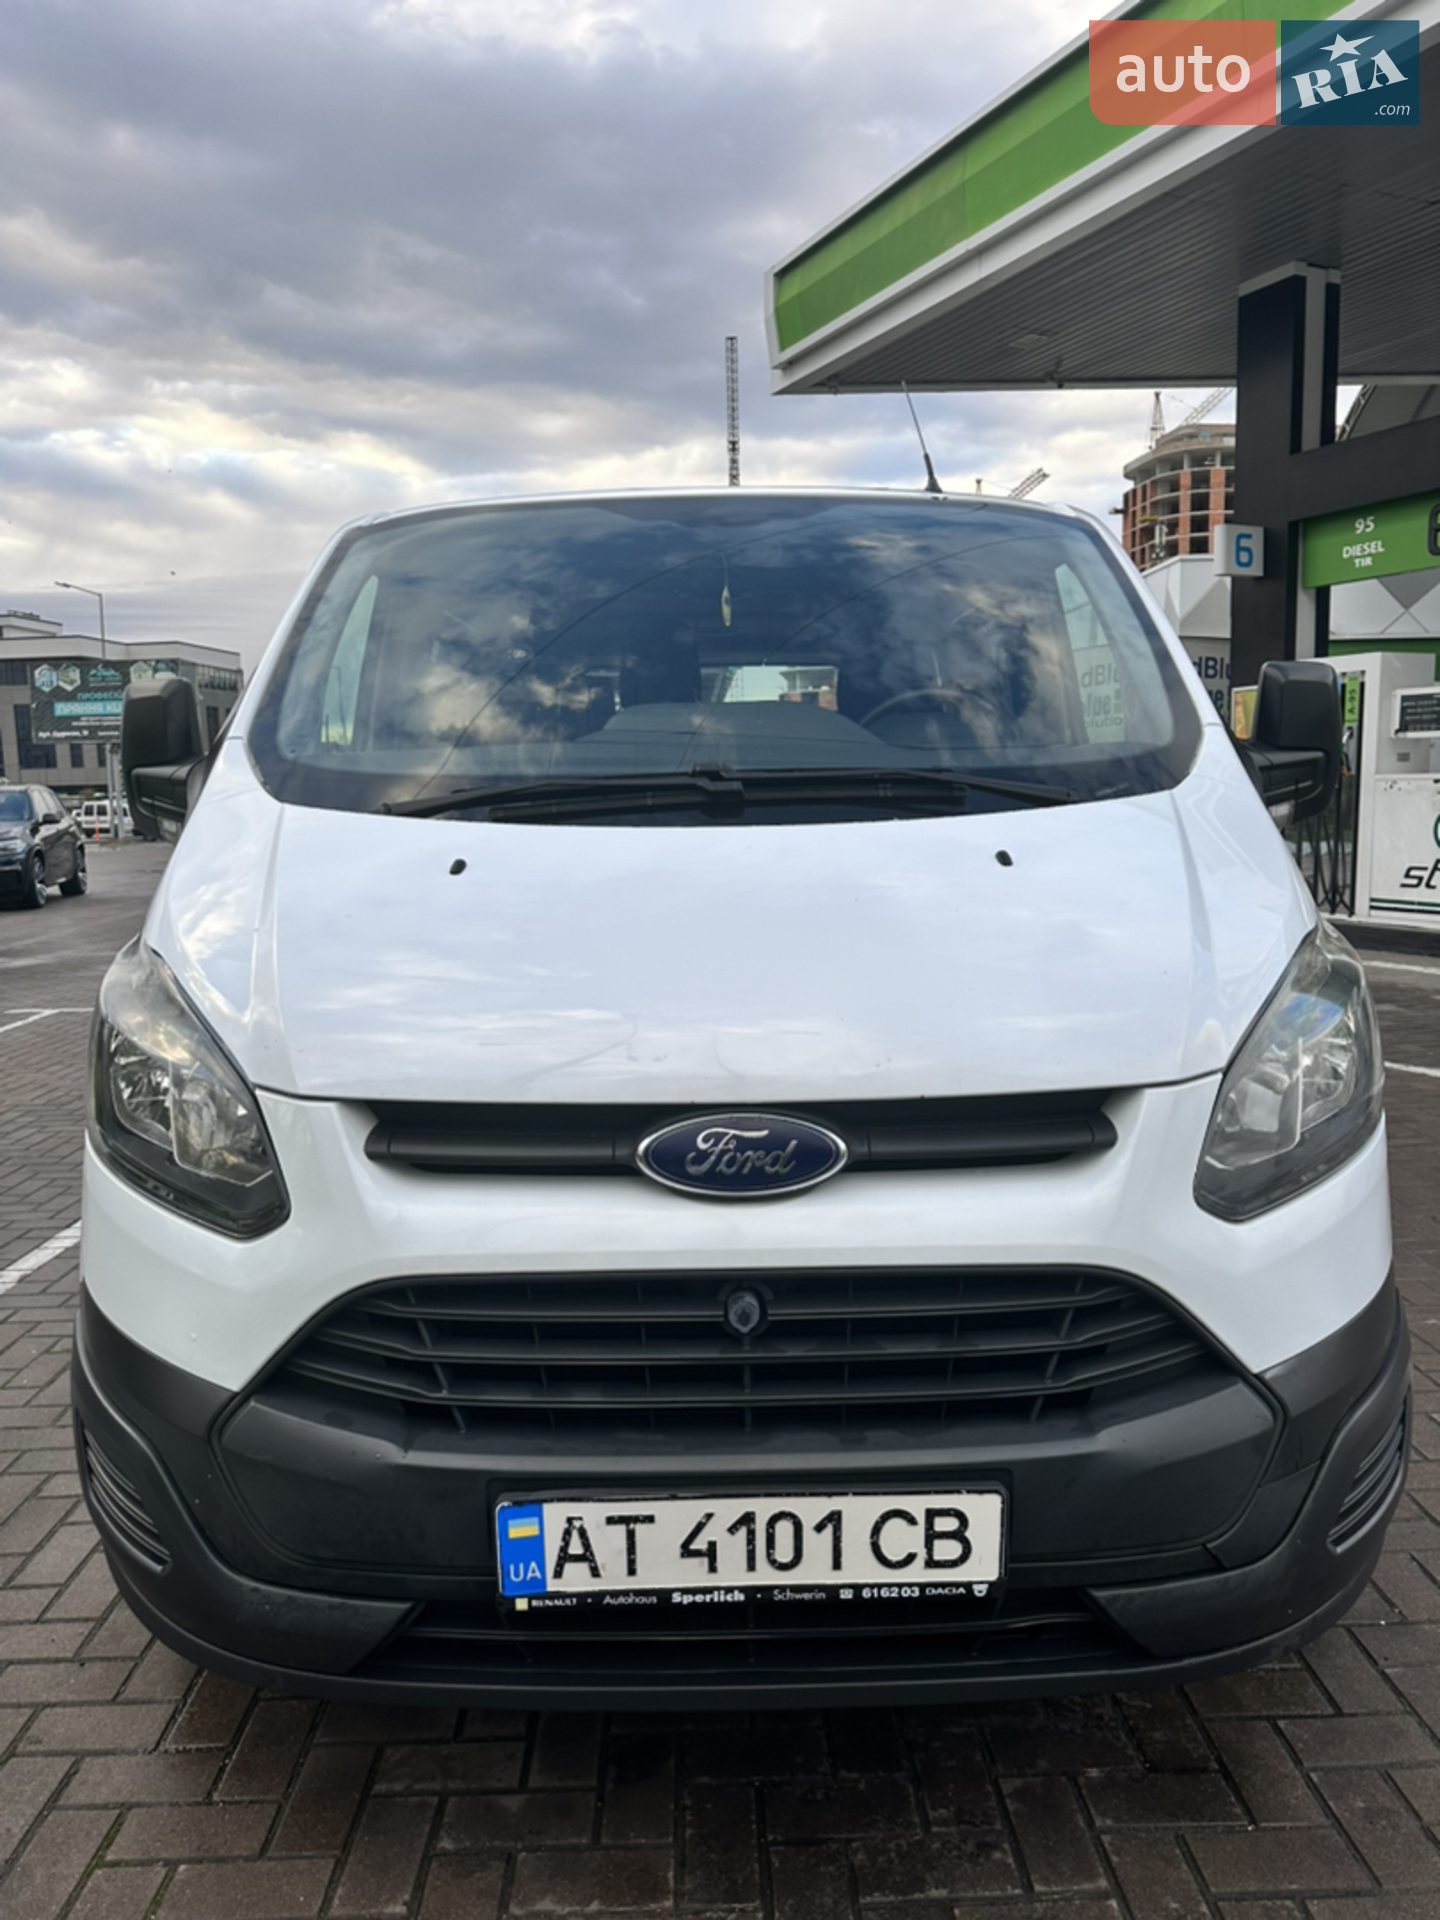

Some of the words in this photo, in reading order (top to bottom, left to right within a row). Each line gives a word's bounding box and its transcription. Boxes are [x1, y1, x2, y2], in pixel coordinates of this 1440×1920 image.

[1354, 516, 1376, 535] 95
[1234, 532, 1254, 569] 6
[1341, 540, 1386, 559] DIESEL
[1353, 556, 1374, 569] TIR
[684, 1126, 799, 1176] Ford
[552, 1513, 656, 1580] AT
[679, 1508, 844, 1574] 4101
[869, 1506, 974, 1571] CB
[509, 1562, 542, 1582] UA
[602, 1593, 658, 1605] Autohaus
[671, 1590, 746, 1605] Sperlich
[772, 1589, 826, 1601] Schwerin
[925, 1586, 967, 1596] DACIA
